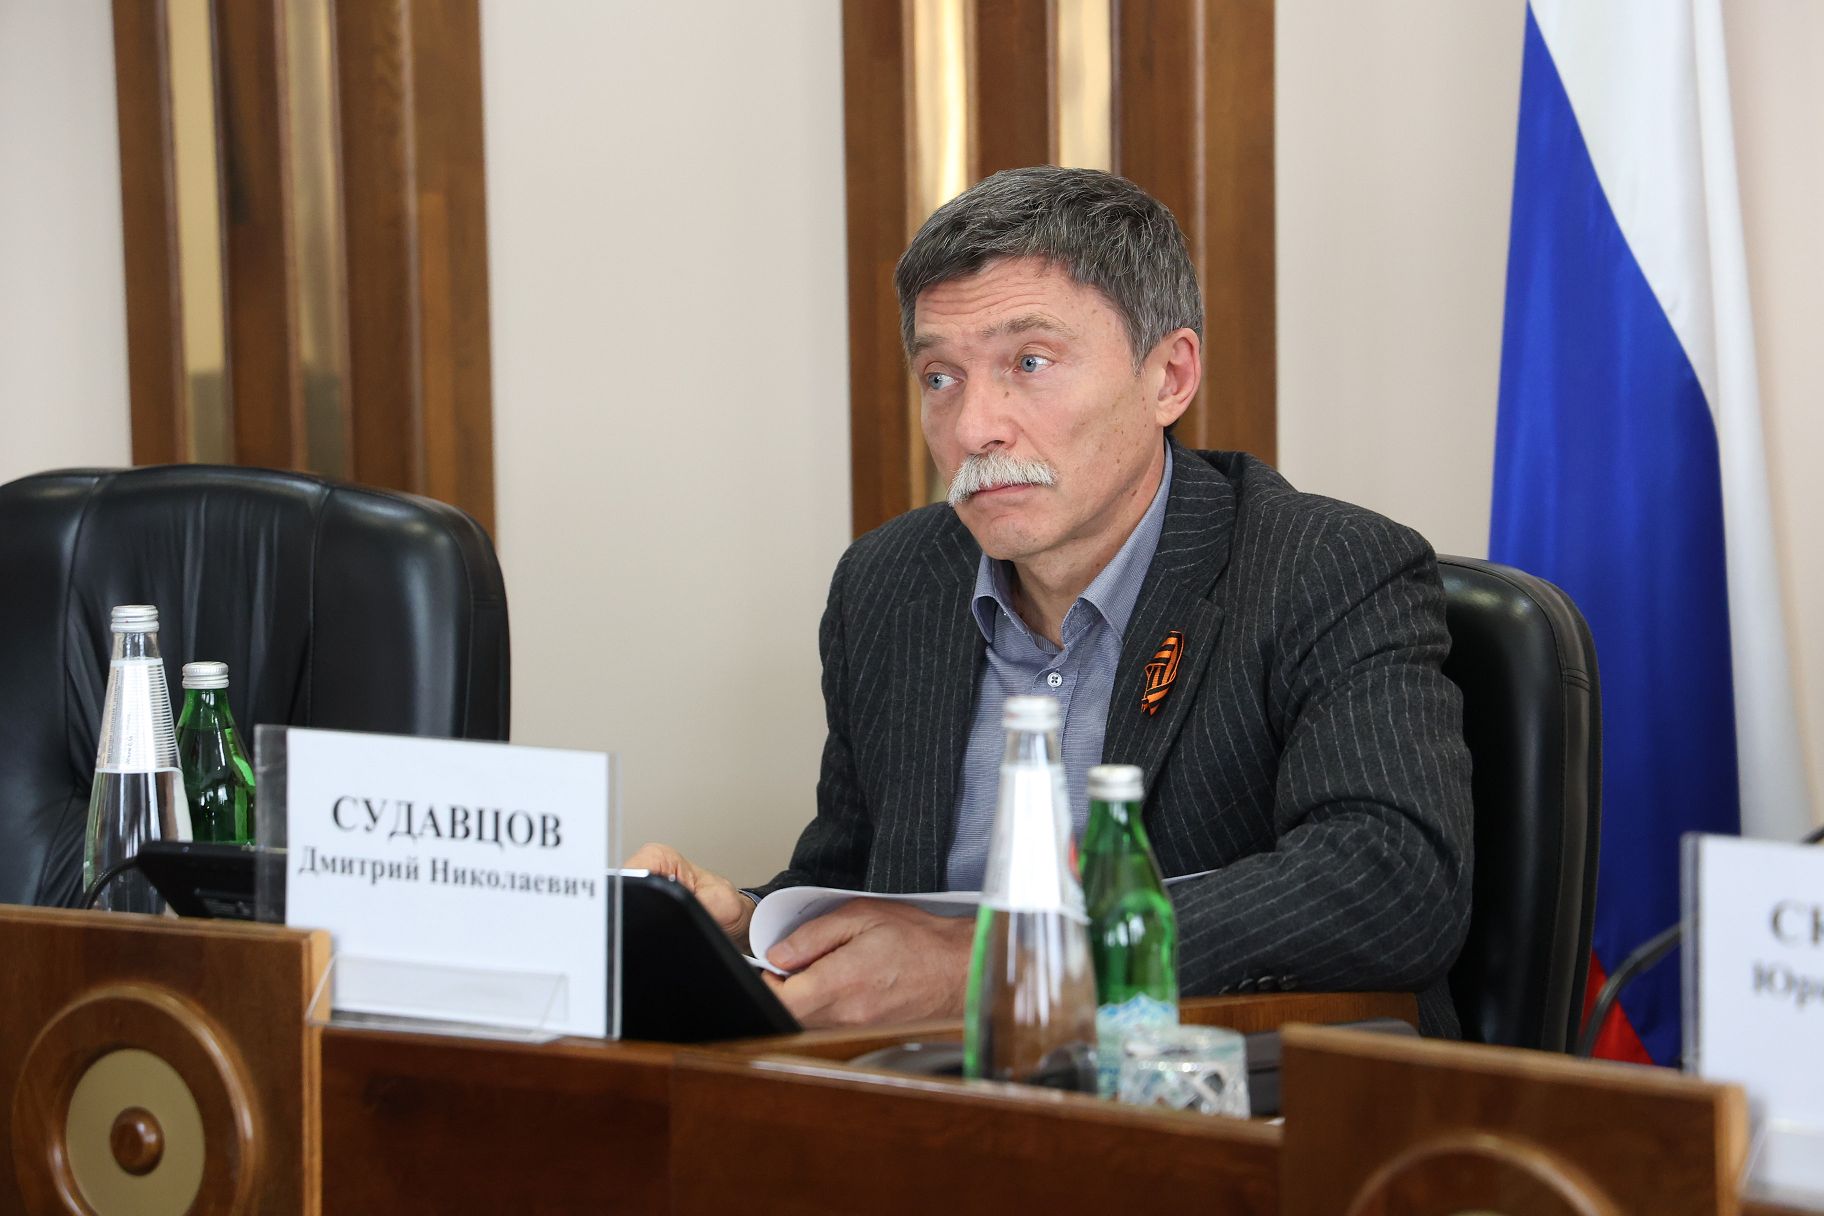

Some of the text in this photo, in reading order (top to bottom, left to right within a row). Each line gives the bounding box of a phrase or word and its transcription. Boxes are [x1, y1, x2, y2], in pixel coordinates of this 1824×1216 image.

[331, 795, 562, 850] СУДАВЦОВ
[298, 845, 596, 897] Дмитрий Николаевич
